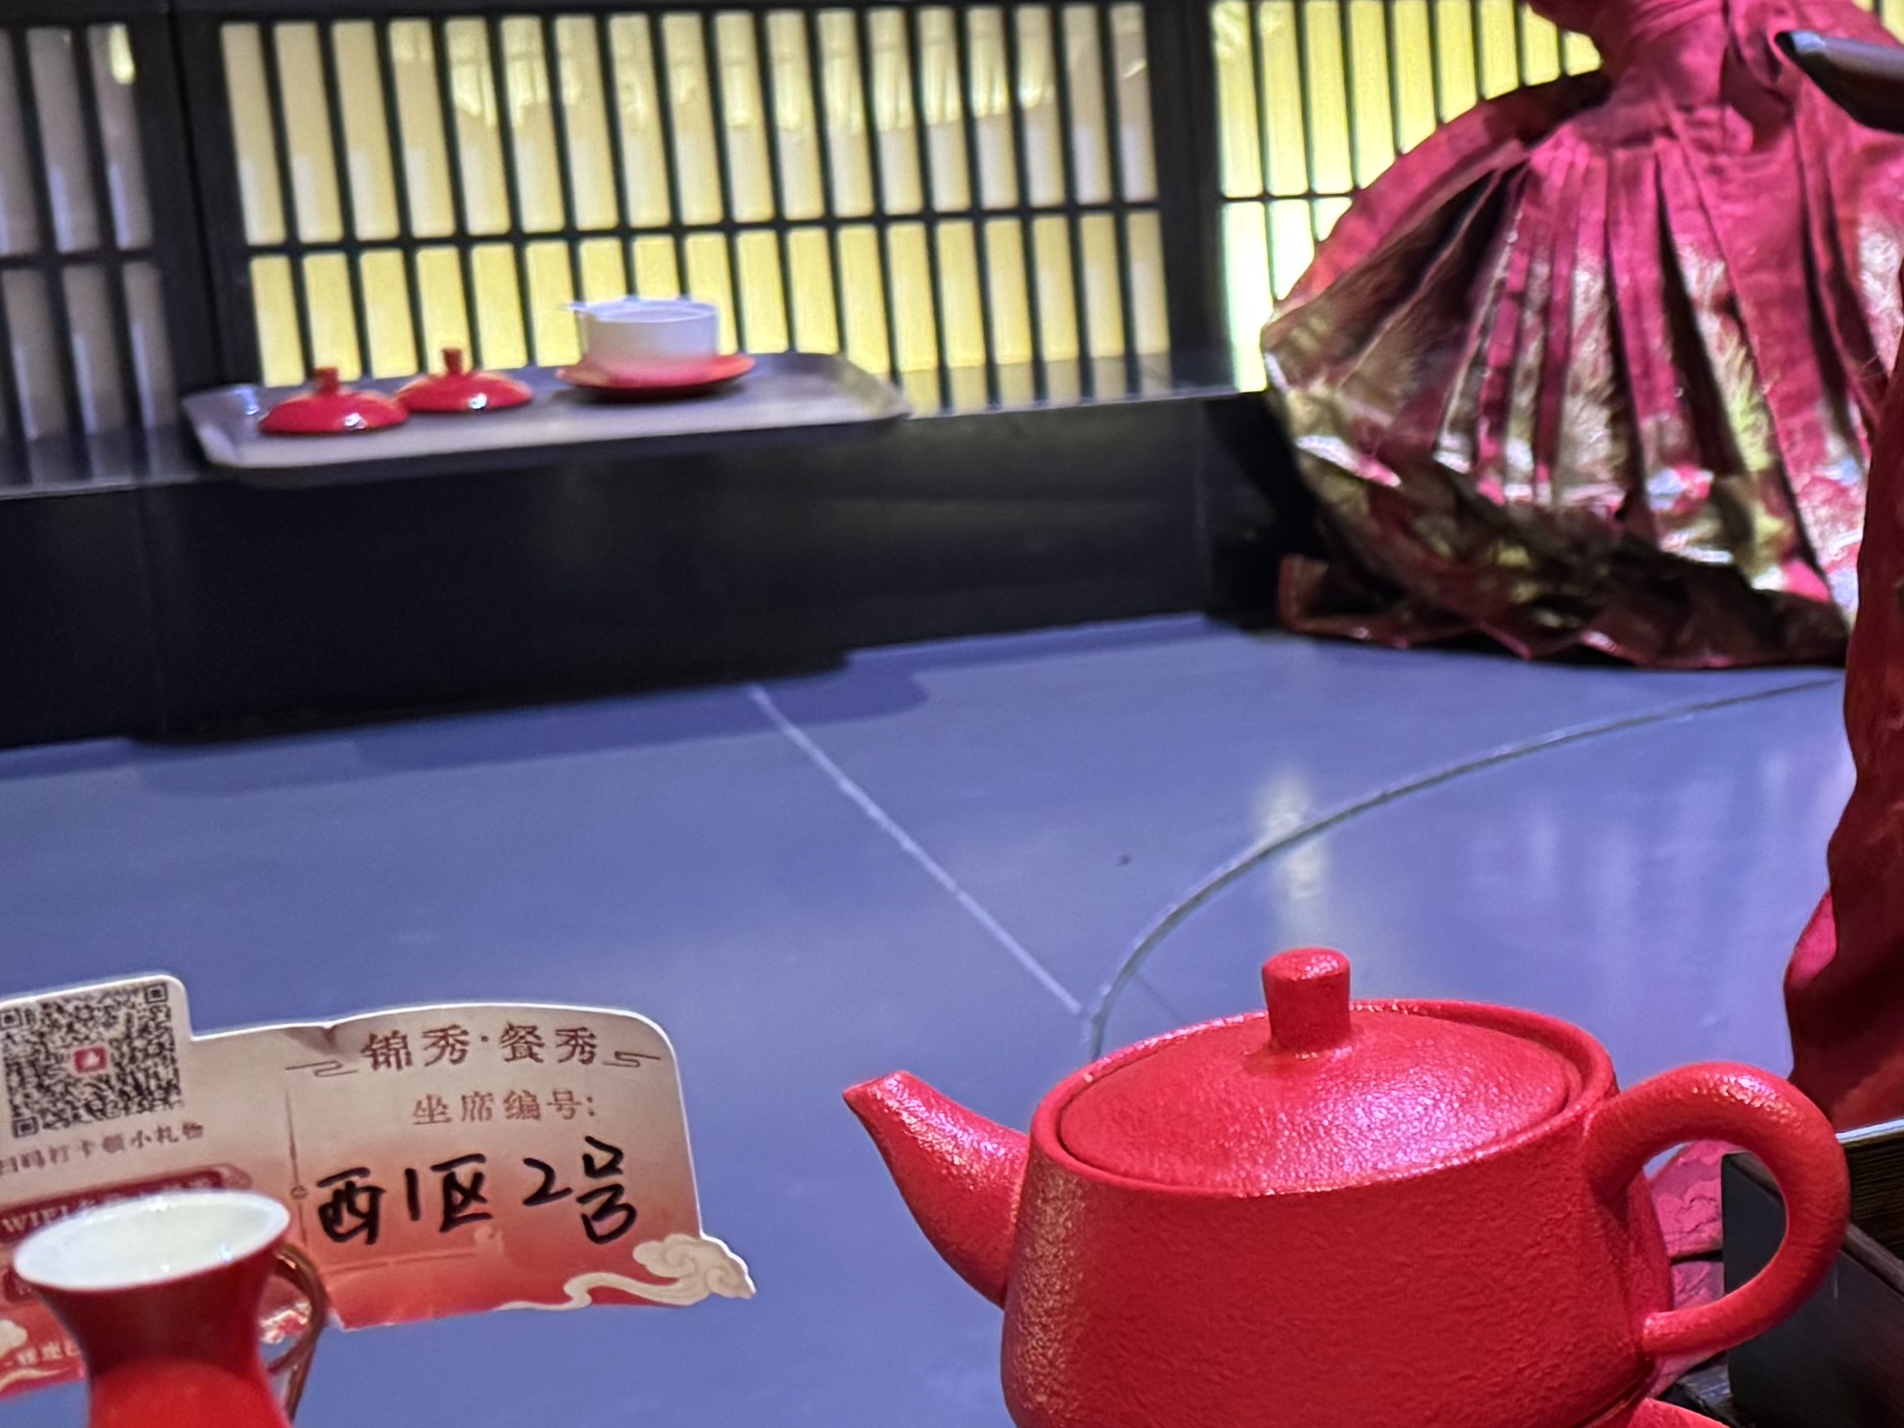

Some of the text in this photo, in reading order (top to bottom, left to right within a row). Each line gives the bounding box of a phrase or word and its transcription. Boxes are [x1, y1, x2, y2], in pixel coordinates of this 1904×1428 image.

[360, 1022, 599, 1072] 锦秀·餐秀
[412, 1088, 597, 1125] 坐席编号:
